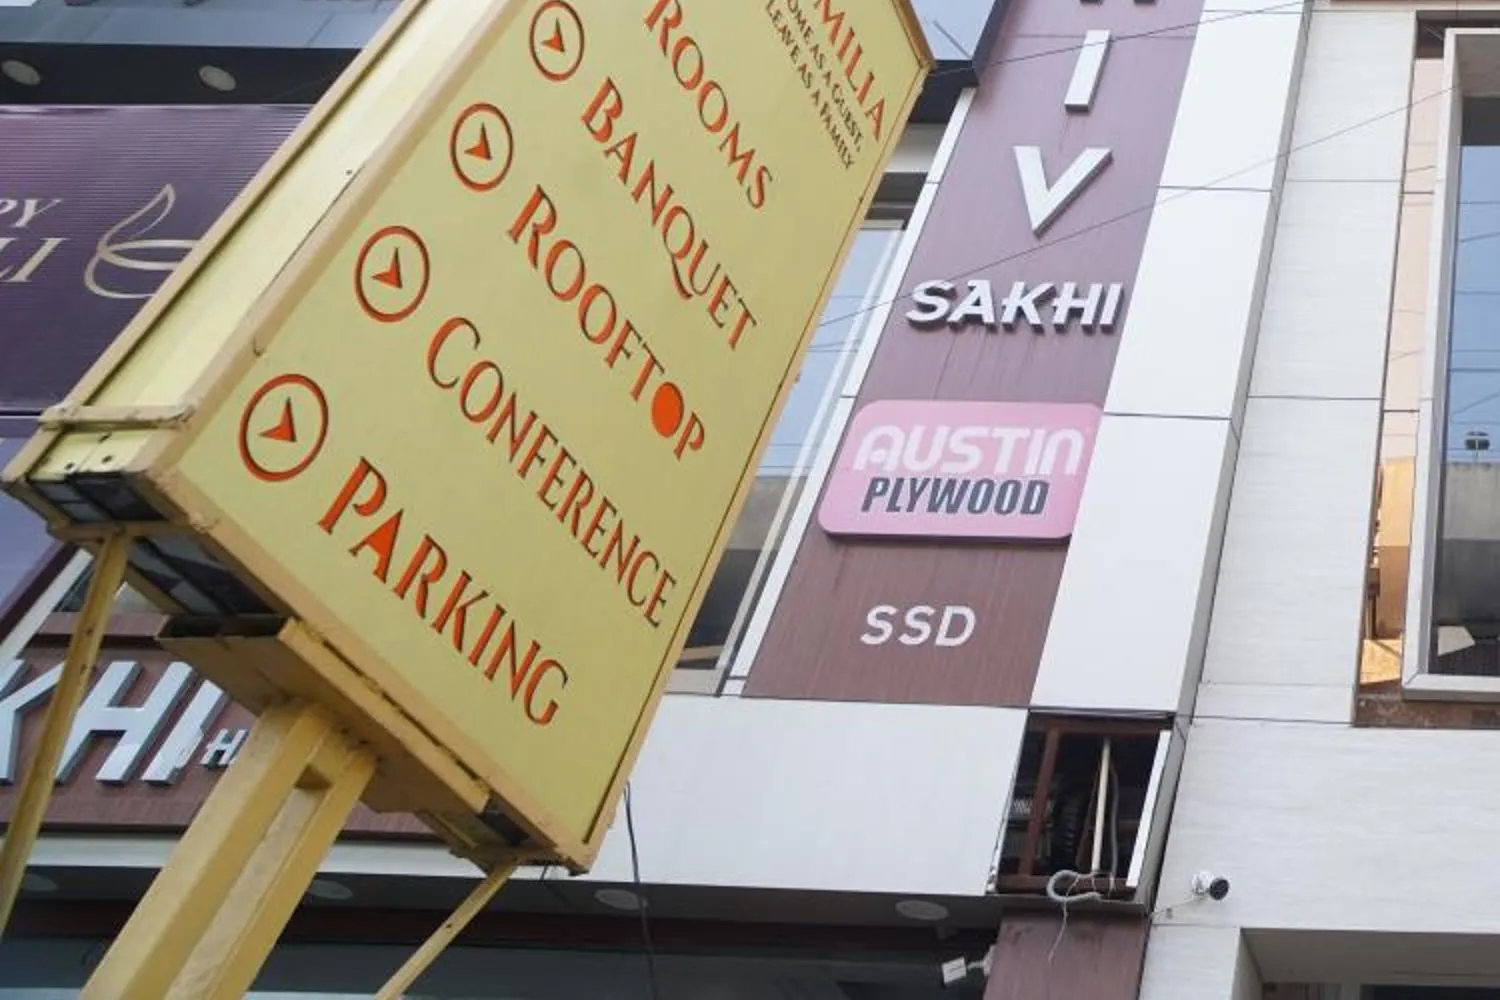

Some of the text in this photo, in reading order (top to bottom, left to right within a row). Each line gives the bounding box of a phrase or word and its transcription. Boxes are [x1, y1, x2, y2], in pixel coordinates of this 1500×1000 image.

[810, 43, 827, 70] AS
[797, 62, 813, 90] AS
[819, 100, 855, 170] FAMILY
[581, 76, 759, 350] BANQUET
[505, 184, 707, 461] ROOFTOP
[904, 278, 1126, 332] SAKHI
[426, 316, 679, 628] CONFERENCE
[853, 424, 1085, 476] AUSTIN
[861, 476, 1051, 516] PLYWOOD
[317, 456, 571, 726] PARKING
[860, 604, 976, 648] SSD
